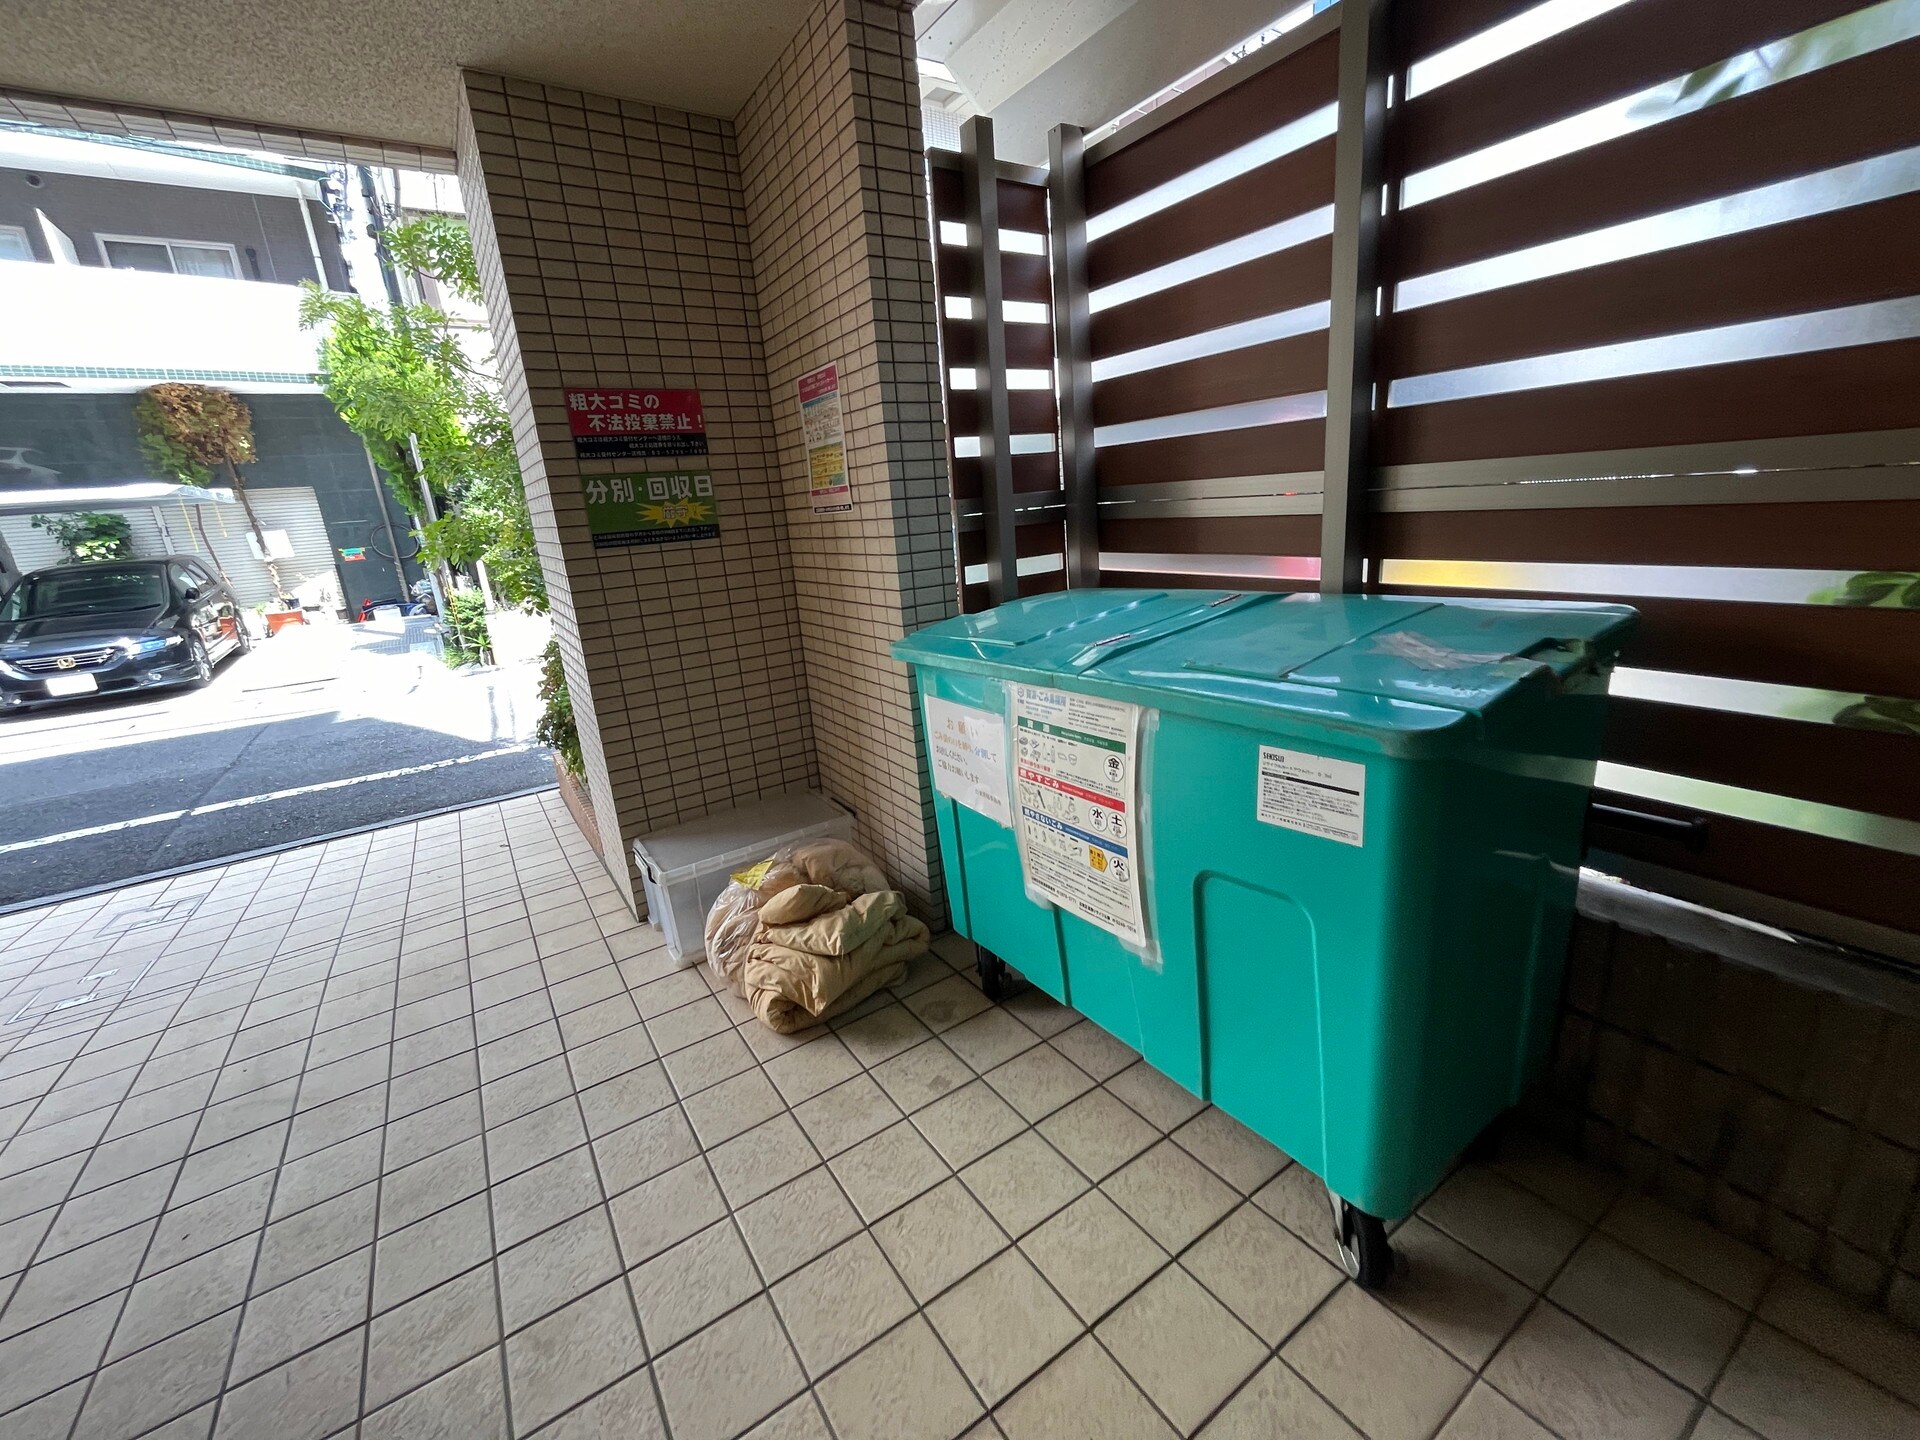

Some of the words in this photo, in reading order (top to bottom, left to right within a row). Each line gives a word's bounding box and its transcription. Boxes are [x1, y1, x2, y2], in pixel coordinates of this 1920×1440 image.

[568, 392, 660, 411] 粗大ゴミの
[587, 413, 704, 432] 不法投棄禁止！
[585, 475, 714, 505] 分別・回収日
[1108, 757, 1120, 770] 金
[1019, 769, 1060, 789] 燃やすごみ
[1092, 808, 1103, 820] 水
[1111, 815, 1123, 827] 土
[1113, 859, 1125, 872] 火
